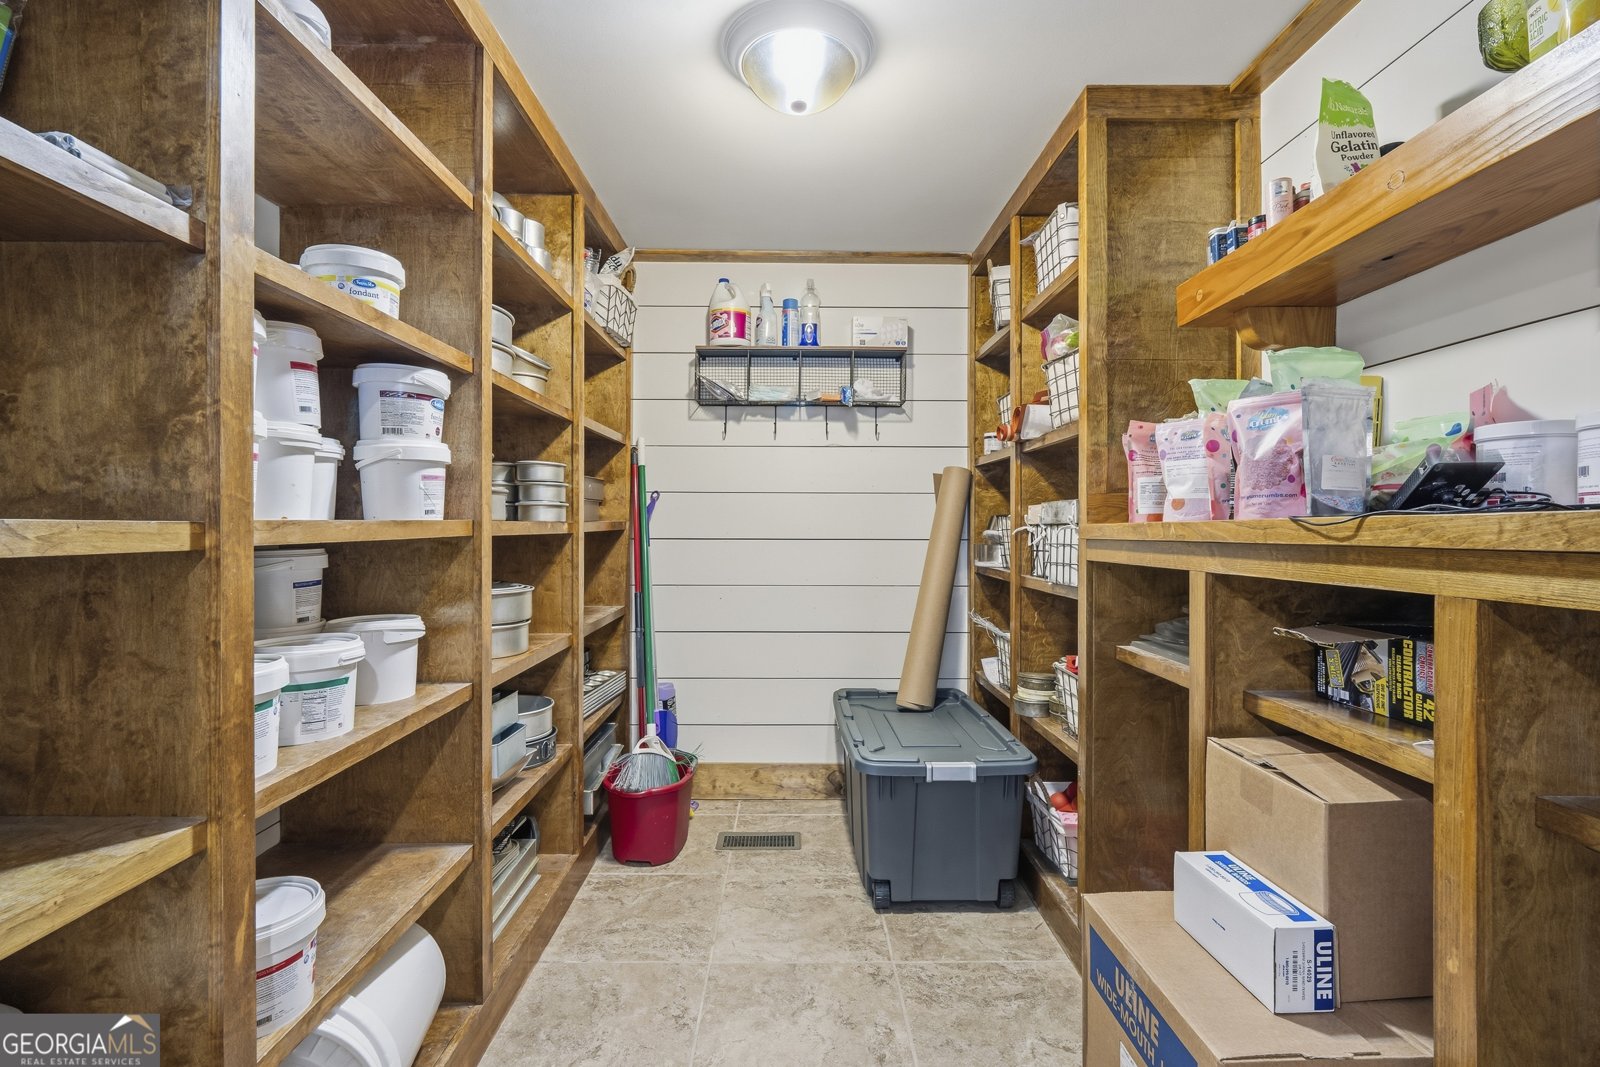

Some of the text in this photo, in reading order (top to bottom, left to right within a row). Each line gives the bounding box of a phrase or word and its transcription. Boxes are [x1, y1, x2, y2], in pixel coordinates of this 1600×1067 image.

[1330, 130, 1376, 140] Unflavored
[1330, 140, 1379, 153] Gelatin
[1340, 152, 1374, 161] Powder
[349, 286, 379, 300] fondant
[1402, 639, 1414, 720] CONTRACTOR
[1415, 692, 1423, 722] GALLON
[1423, 698, 1435, 722] 42
[1316, 941, 1333, 1000] ULINE
[1096, 968, 1155, 1066] WIDE-MOUTH
